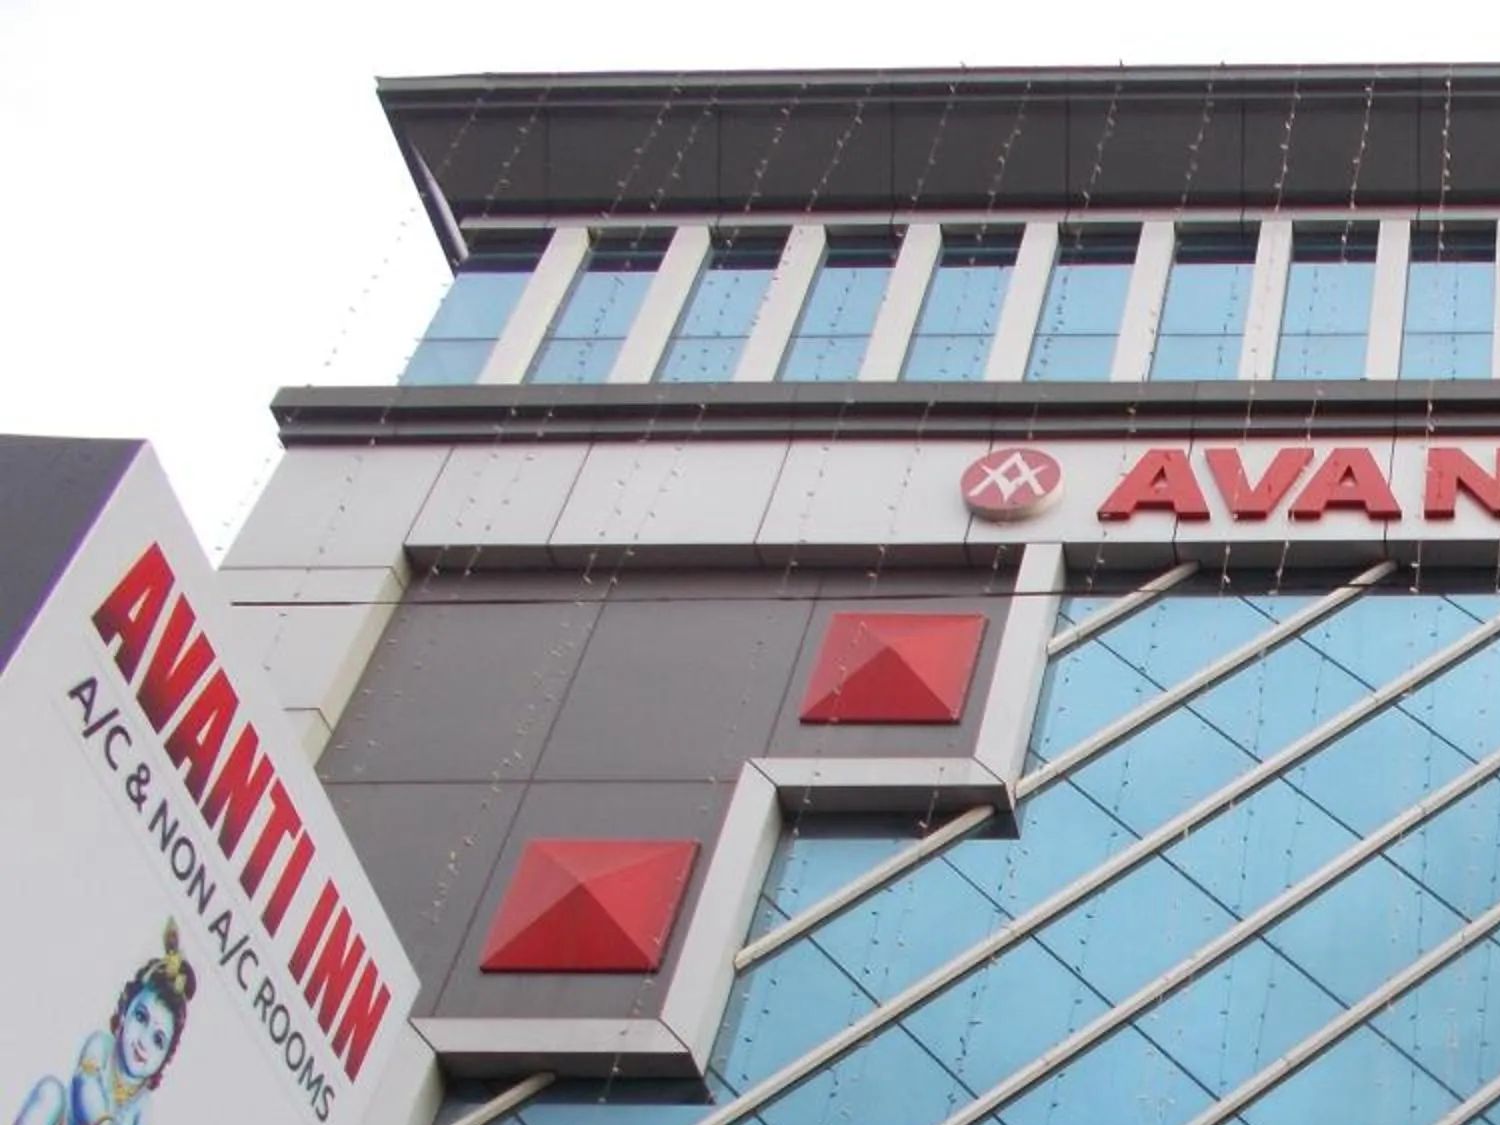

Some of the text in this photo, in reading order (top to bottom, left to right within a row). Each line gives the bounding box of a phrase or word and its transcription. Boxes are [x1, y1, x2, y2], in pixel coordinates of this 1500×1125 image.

[68, 676, 335, 1122] A/C & NON A/C ROOMS
[91, 541, 391, 1084] AVANTI INN
